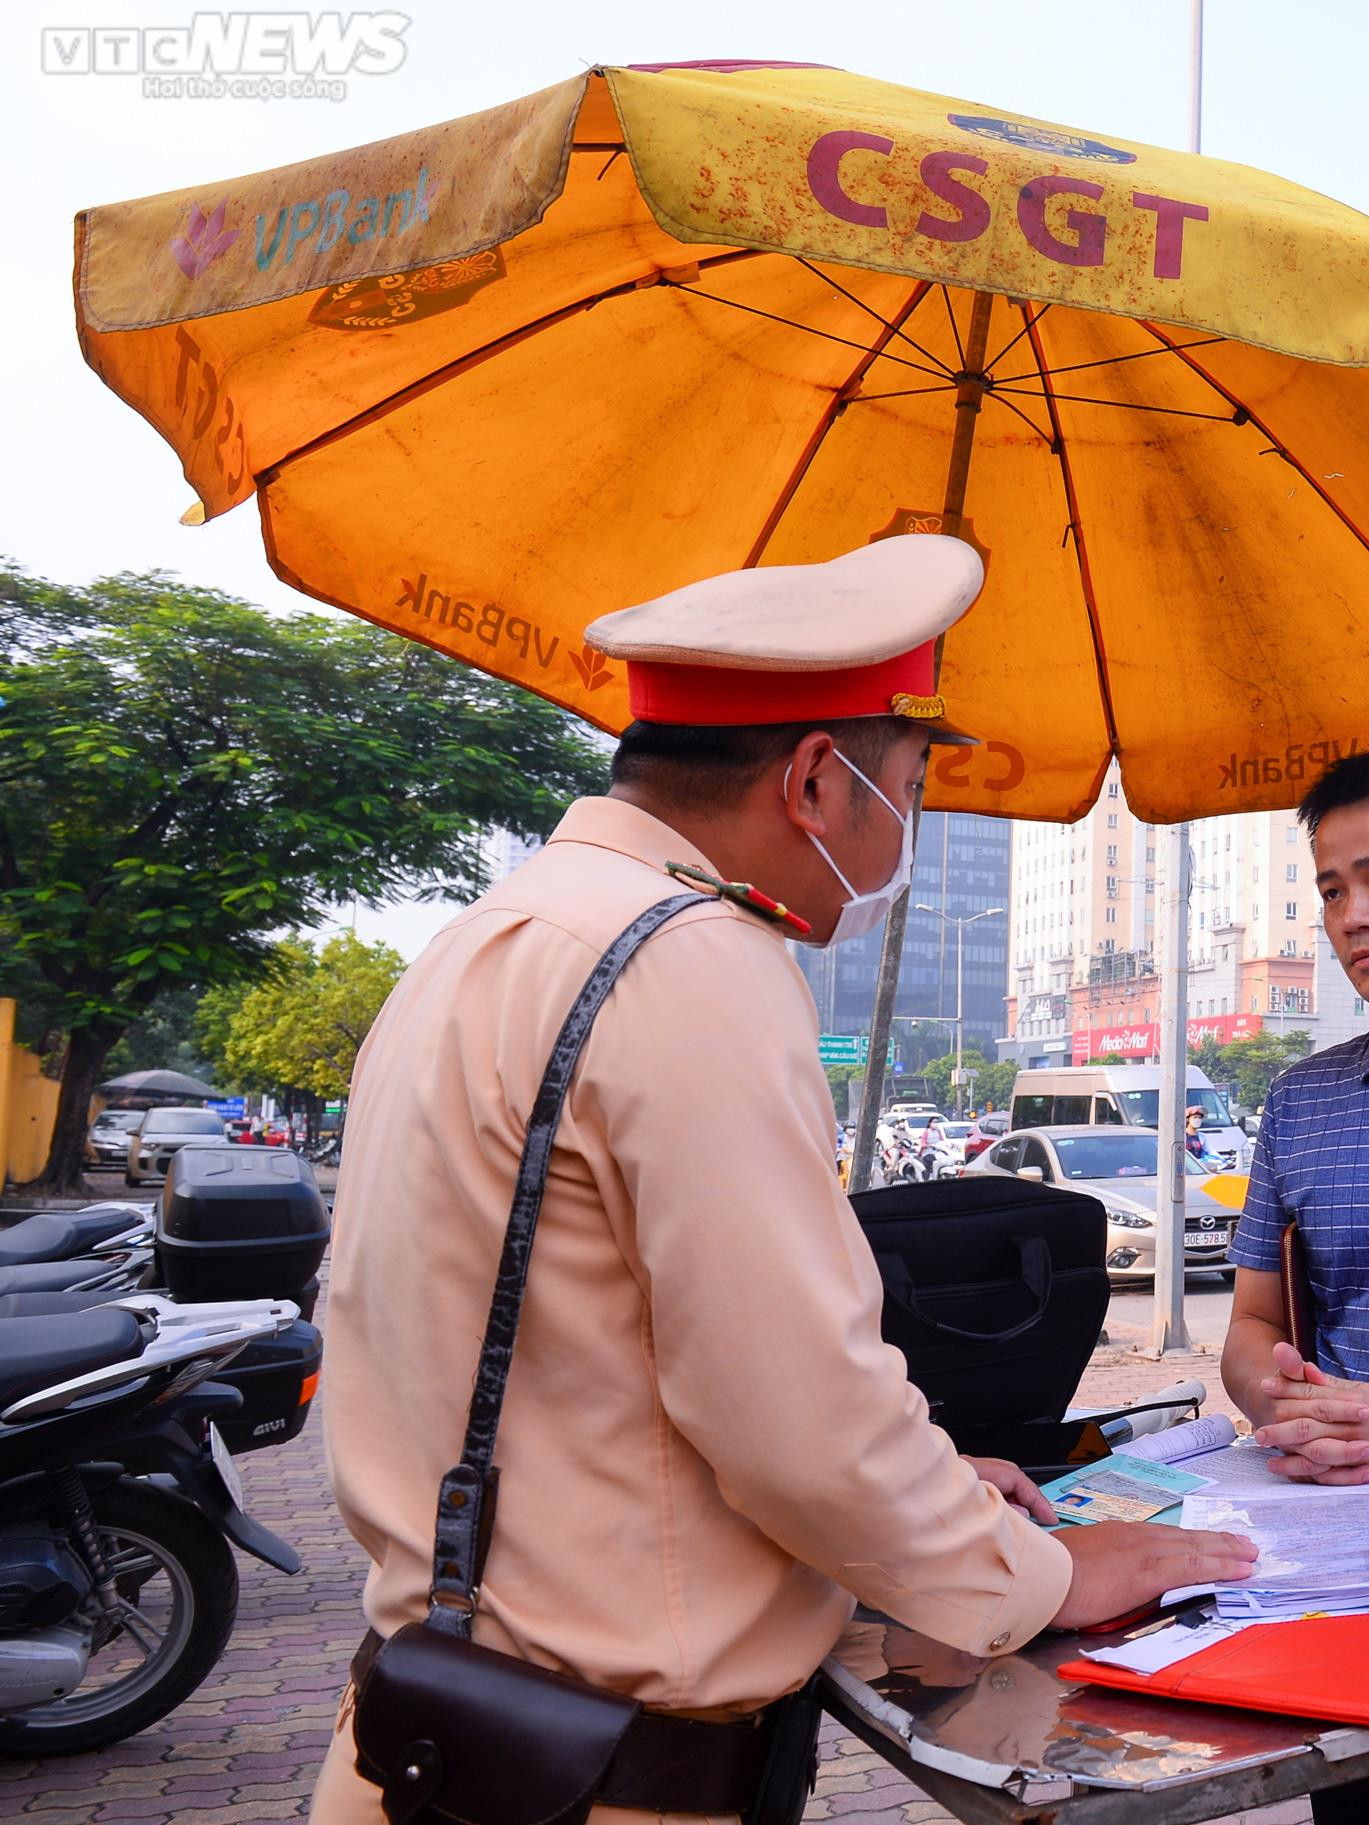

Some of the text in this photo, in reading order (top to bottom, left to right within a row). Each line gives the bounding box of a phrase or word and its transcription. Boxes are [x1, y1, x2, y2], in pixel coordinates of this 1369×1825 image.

[255, 166, 437, 272] VPBank
[807, 129, 1209, 280] CSGT
[252, 1418, 286, 1437] GIVI
